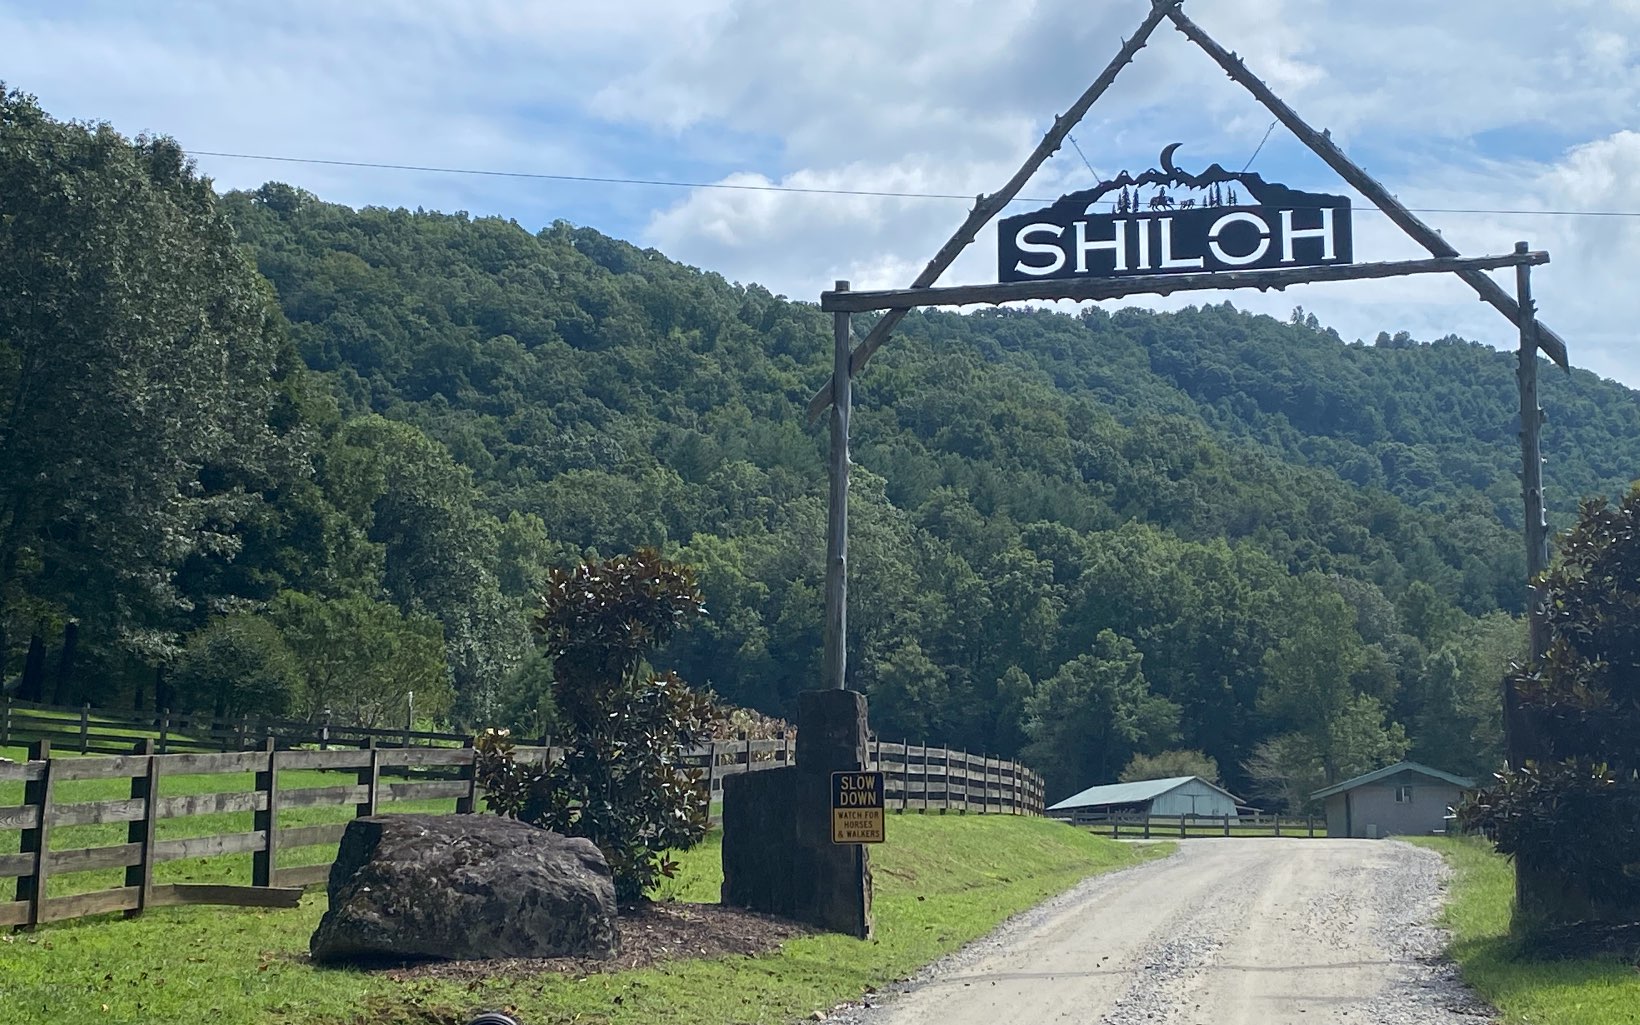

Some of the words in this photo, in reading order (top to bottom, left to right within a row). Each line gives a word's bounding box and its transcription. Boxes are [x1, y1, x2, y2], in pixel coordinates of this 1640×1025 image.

[1014, 208, 1336, 275] SHILOH
[841, 776, 875, 790] SLOW
[840, 791, 876, 805] DOWN
[838, 811, 862, 819] WATCH
[865, 811, 879, 819] FOR
[844, 821, 873, 829] HORSES
[838, 830, 843, 838] &
[847, 830, 880, 838] WALKERS
